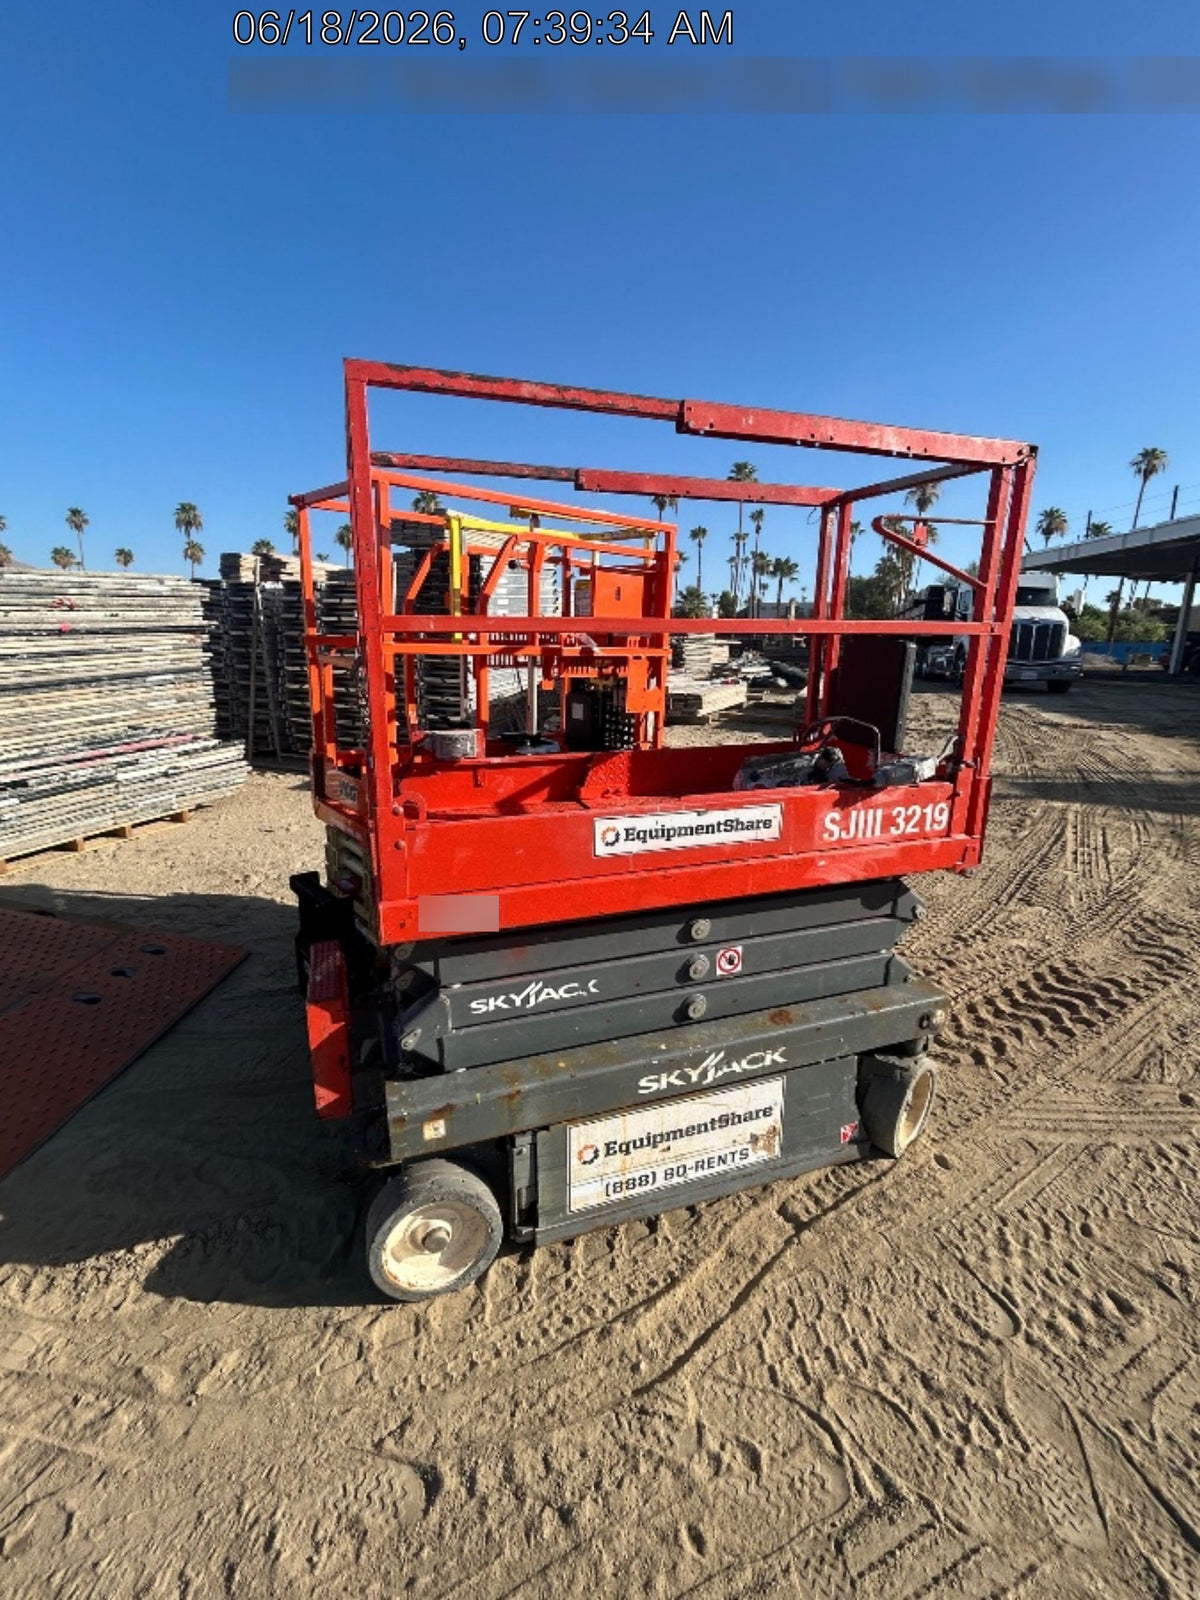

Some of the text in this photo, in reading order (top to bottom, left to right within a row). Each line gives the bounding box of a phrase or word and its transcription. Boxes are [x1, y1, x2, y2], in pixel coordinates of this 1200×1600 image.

[623, 818, 772, 843] EquipmentShare
[890, 803, 949, 835] 3219
[637, 1046, 788, 1095] SKYJACK
[604, 1105, 773, 1157] EquipmentShare
[605, 1170, 657, 1198] (888)
